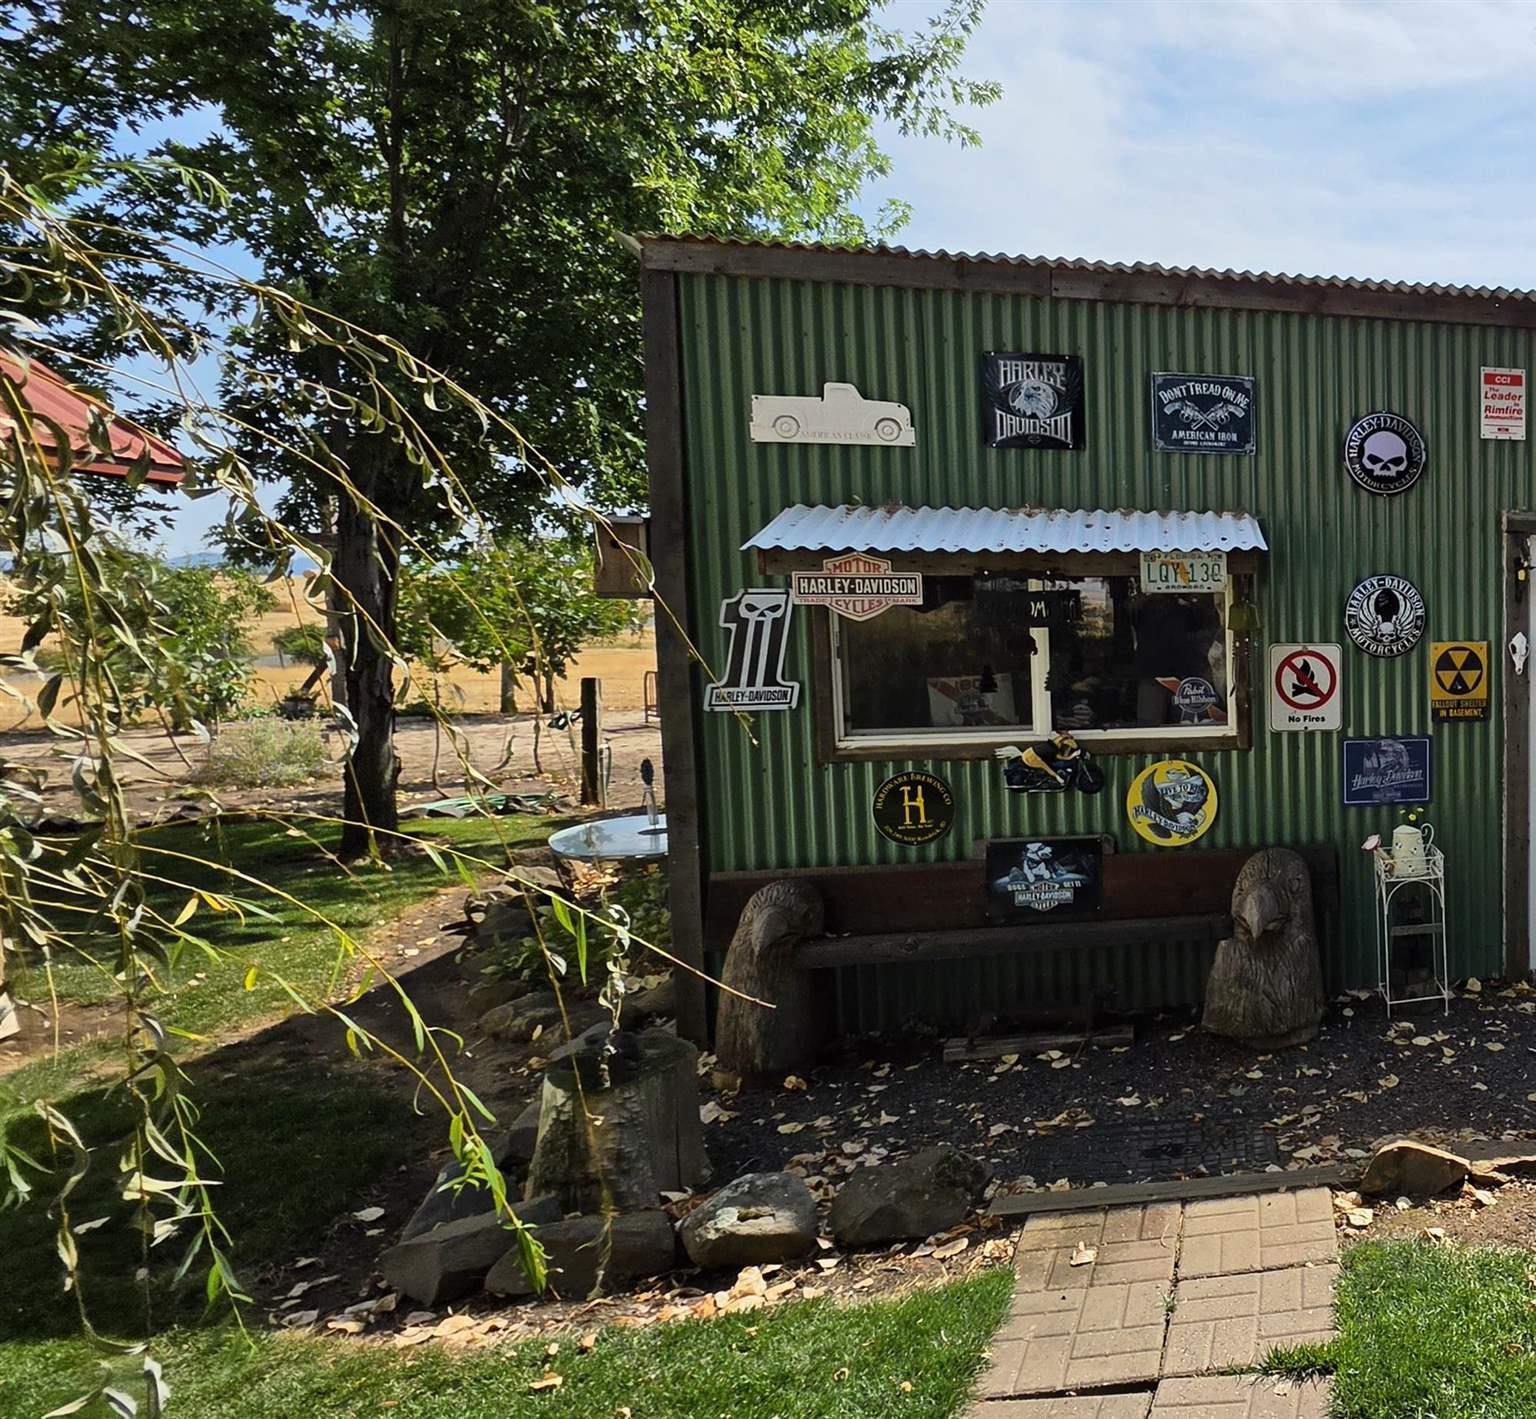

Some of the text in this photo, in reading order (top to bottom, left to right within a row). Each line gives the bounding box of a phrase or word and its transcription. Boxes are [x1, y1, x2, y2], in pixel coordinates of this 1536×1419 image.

[999, 360, 1066, 391] HARLEY
[1495, 376, 1511, 384] CCI
[1186, 382, 1221, 396] TREAD
[1222, 386, 1236, 401] ON
[1233, 392, 1250, 409] ME
[1484, 391, 1523, 401] Leader
[1484, 405, 1523, 415] Rimfire
[995, 407, 1072, 445] DAVIDSON
[1171, 430, 1238, 441] AMERICAN IRON
[1352, 464, 1417, 489] MOTORCYCLES
[832, 557, 882, 573] MOTOR
[800, 578, 916, 594] HARLEY-DAVIDSON
[1347, 577, 1425, 615] HARLEY-DAVIDSON
[834, 598, 884, 614] CYCLES
[1350, 627, 1420, 655] MOTORCYCLES
[1183, 683, 1206, 695] Pabst
[1431, 700, 1486, 708] FALLOUT SHELTER
[1288, 715, 1301, 723] No
[1440, 709, 1447, 717] IN
[875, 776, 907, 809] HARDWARE
[910, 773, 945, 794] BREWING
[1018, 891, 1073, 901] HARLEY-DAVIDSON
